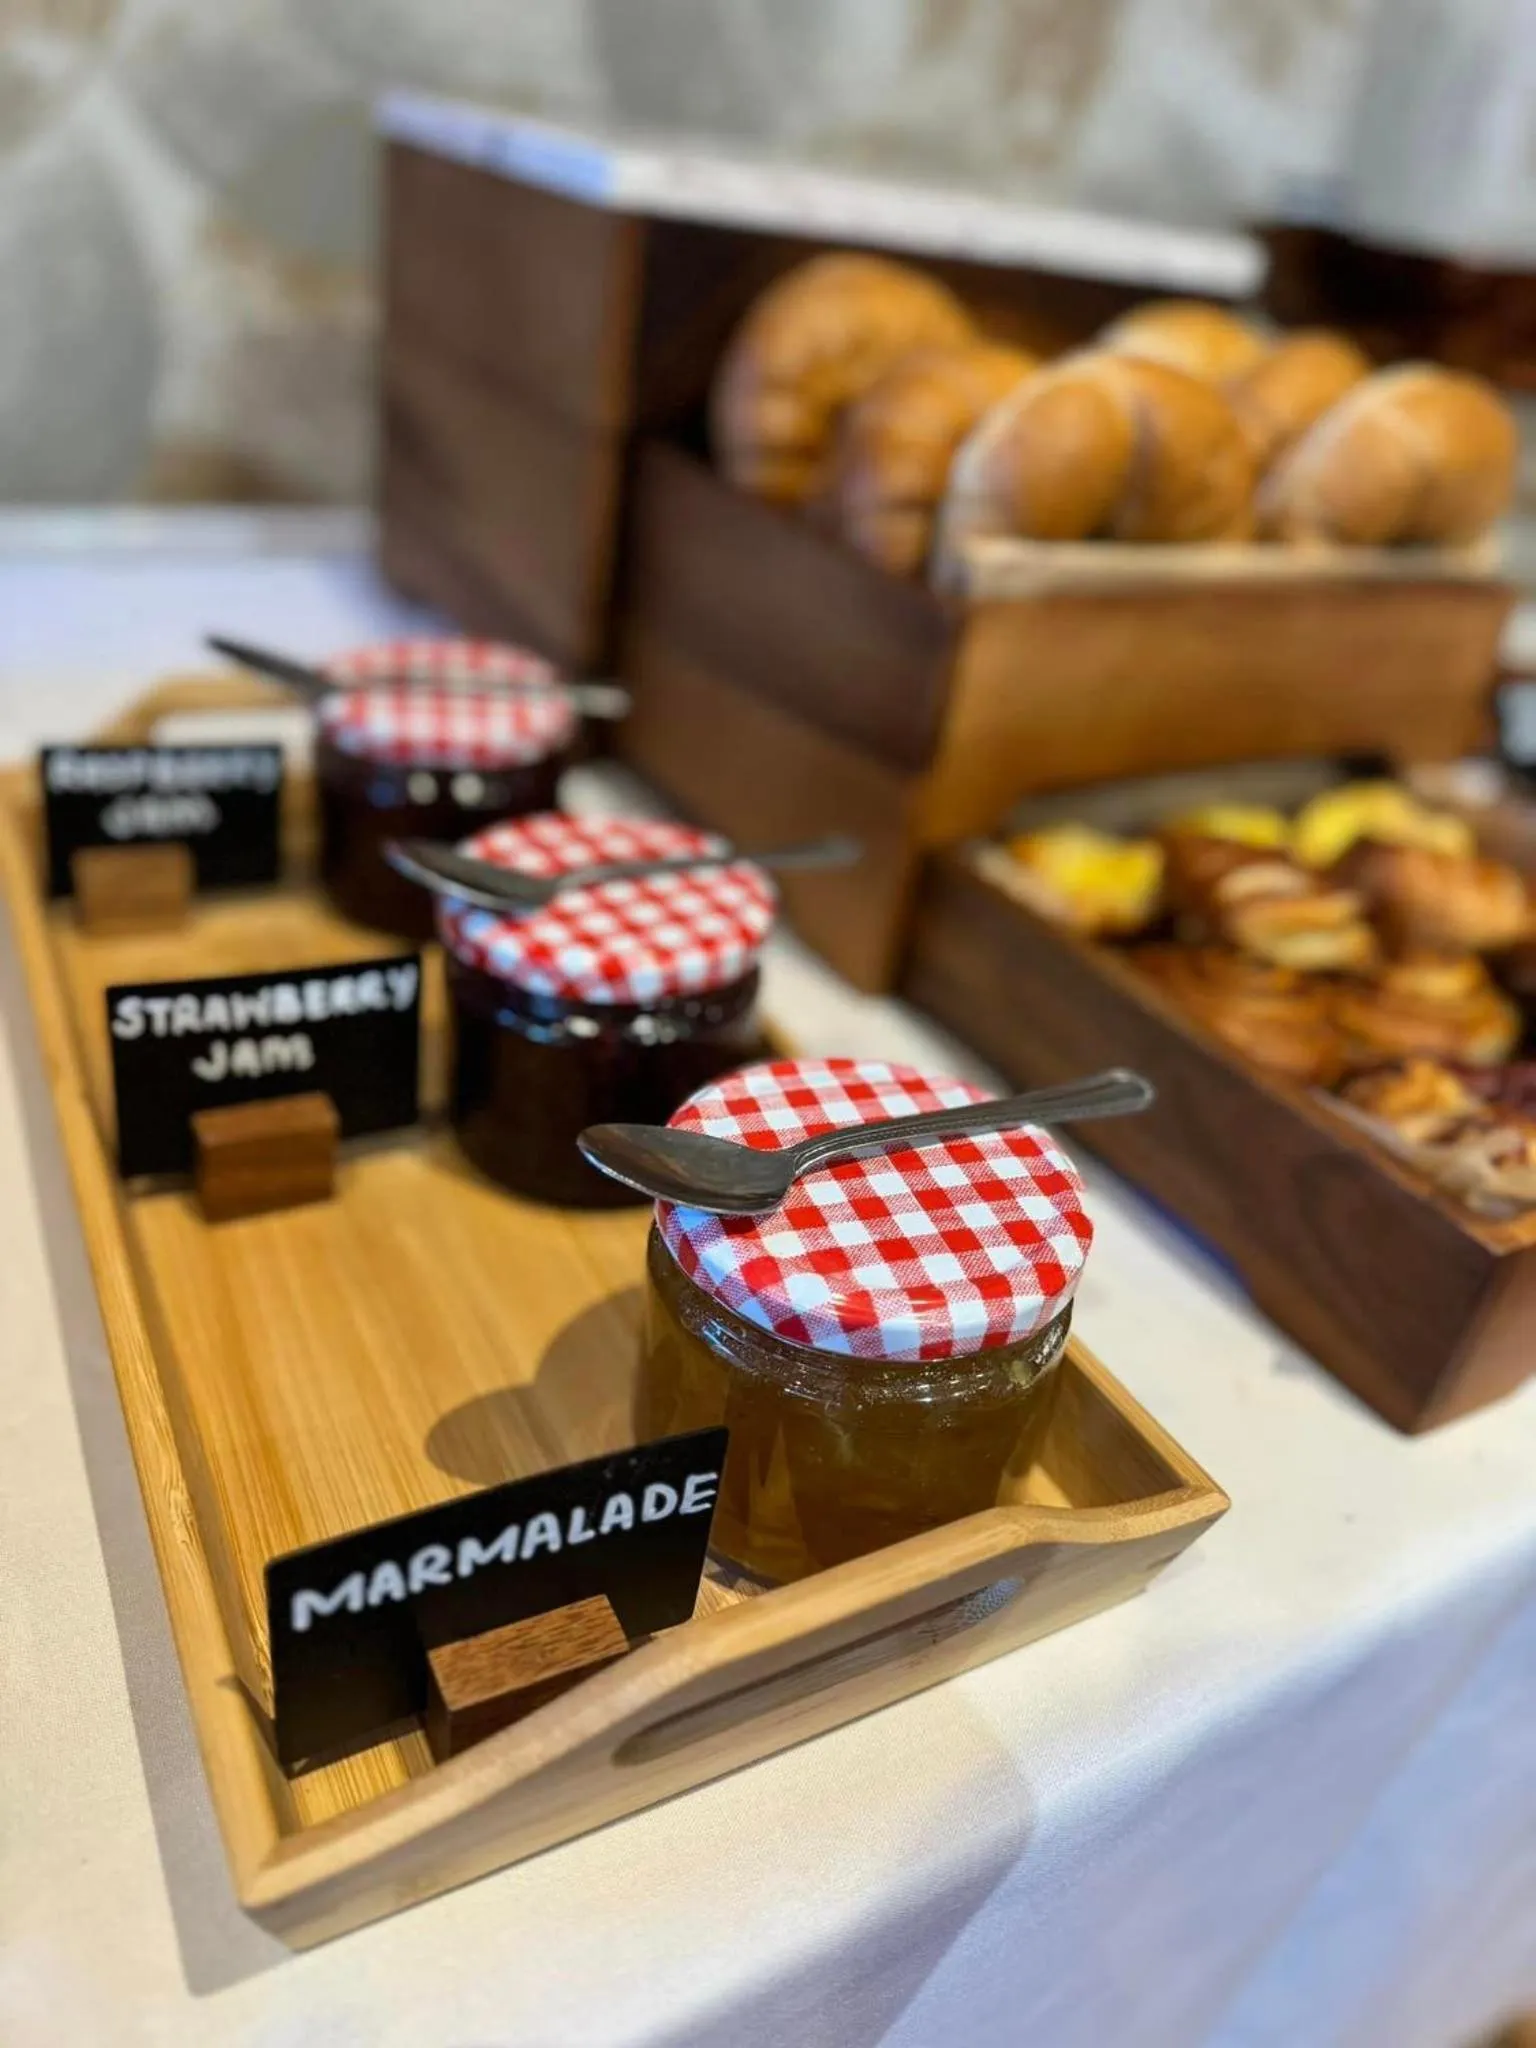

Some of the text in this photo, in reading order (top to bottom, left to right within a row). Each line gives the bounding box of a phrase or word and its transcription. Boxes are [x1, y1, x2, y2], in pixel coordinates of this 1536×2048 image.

[112, 963, 418, 1040] STRAWBERRY
[191, 1032, 316, 1082] JAM
[290, 1471, 719, 1632] MARMALADE
